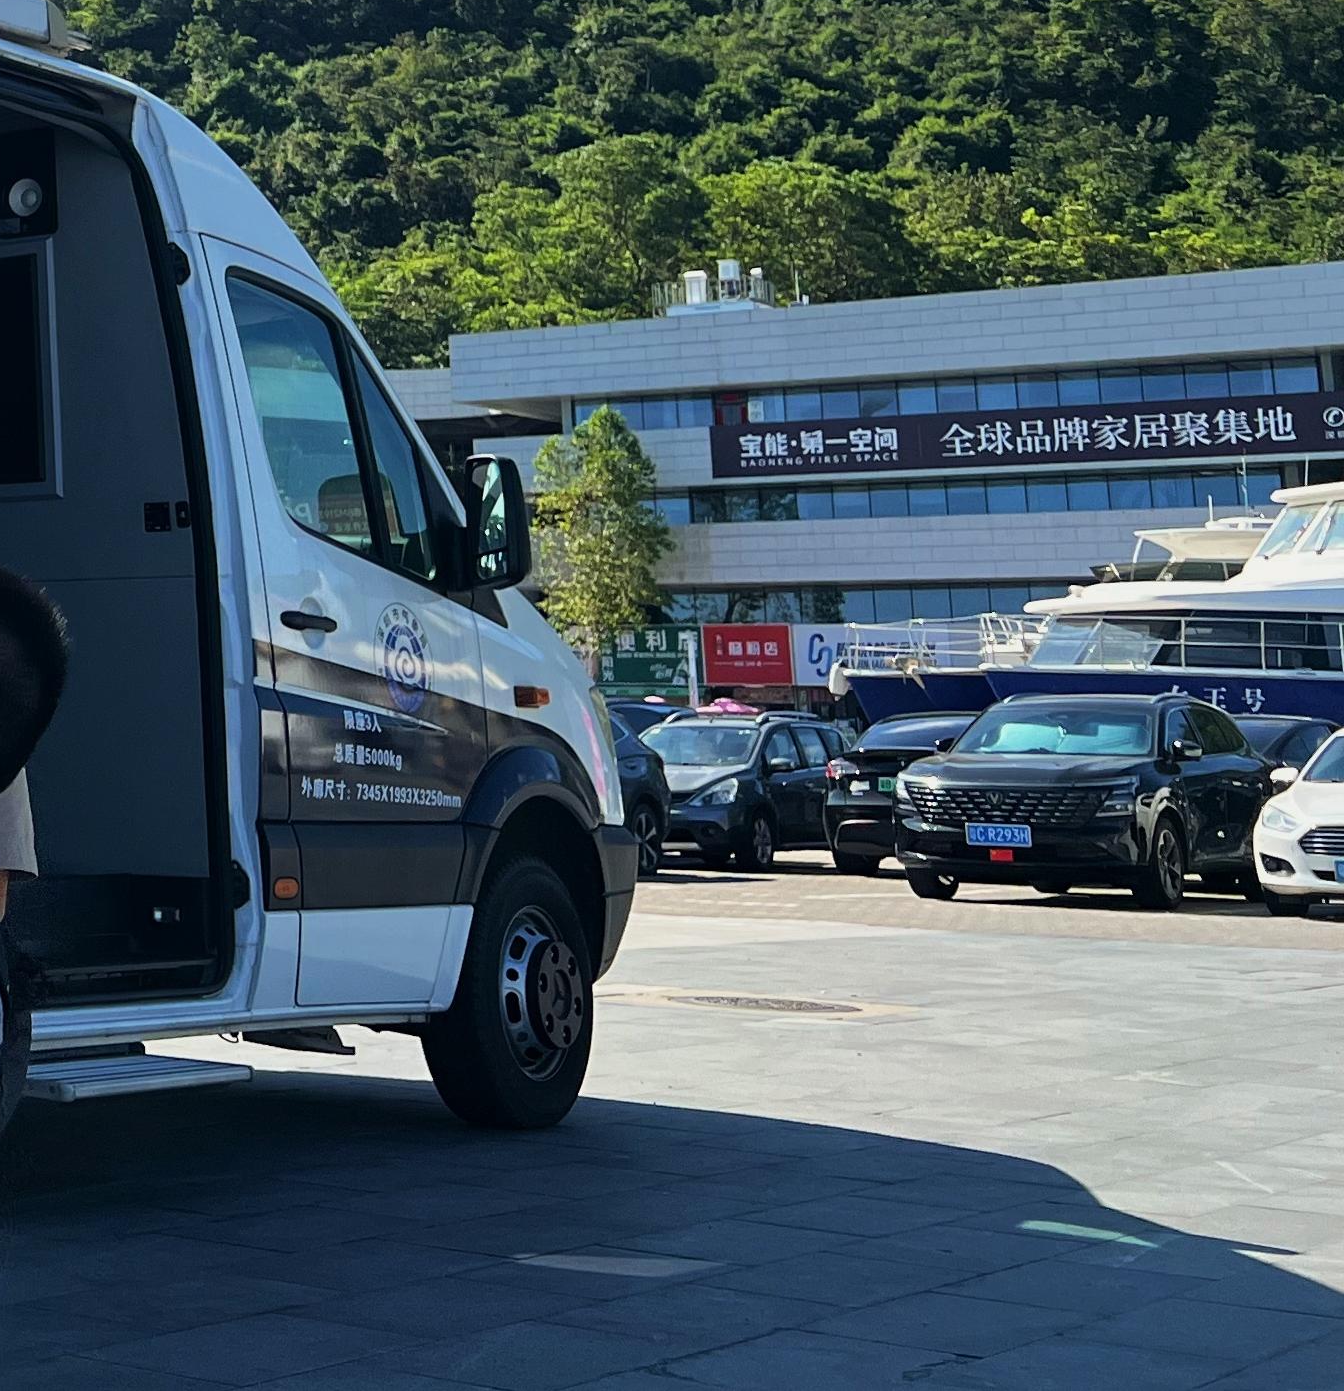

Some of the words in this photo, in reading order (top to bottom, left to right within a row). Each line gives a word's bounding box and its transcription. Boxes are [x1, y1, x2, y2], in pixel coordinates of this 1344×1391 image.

[939, 406, 1297, 458] 全球品牌家居聚集地
[740, 457, 803, 469] BAONENG
[810, 454, 848, 465] FIRST
[856, 451, 899, 463] SPACE
[333, 742, 402, 772] 总质量5000kg
